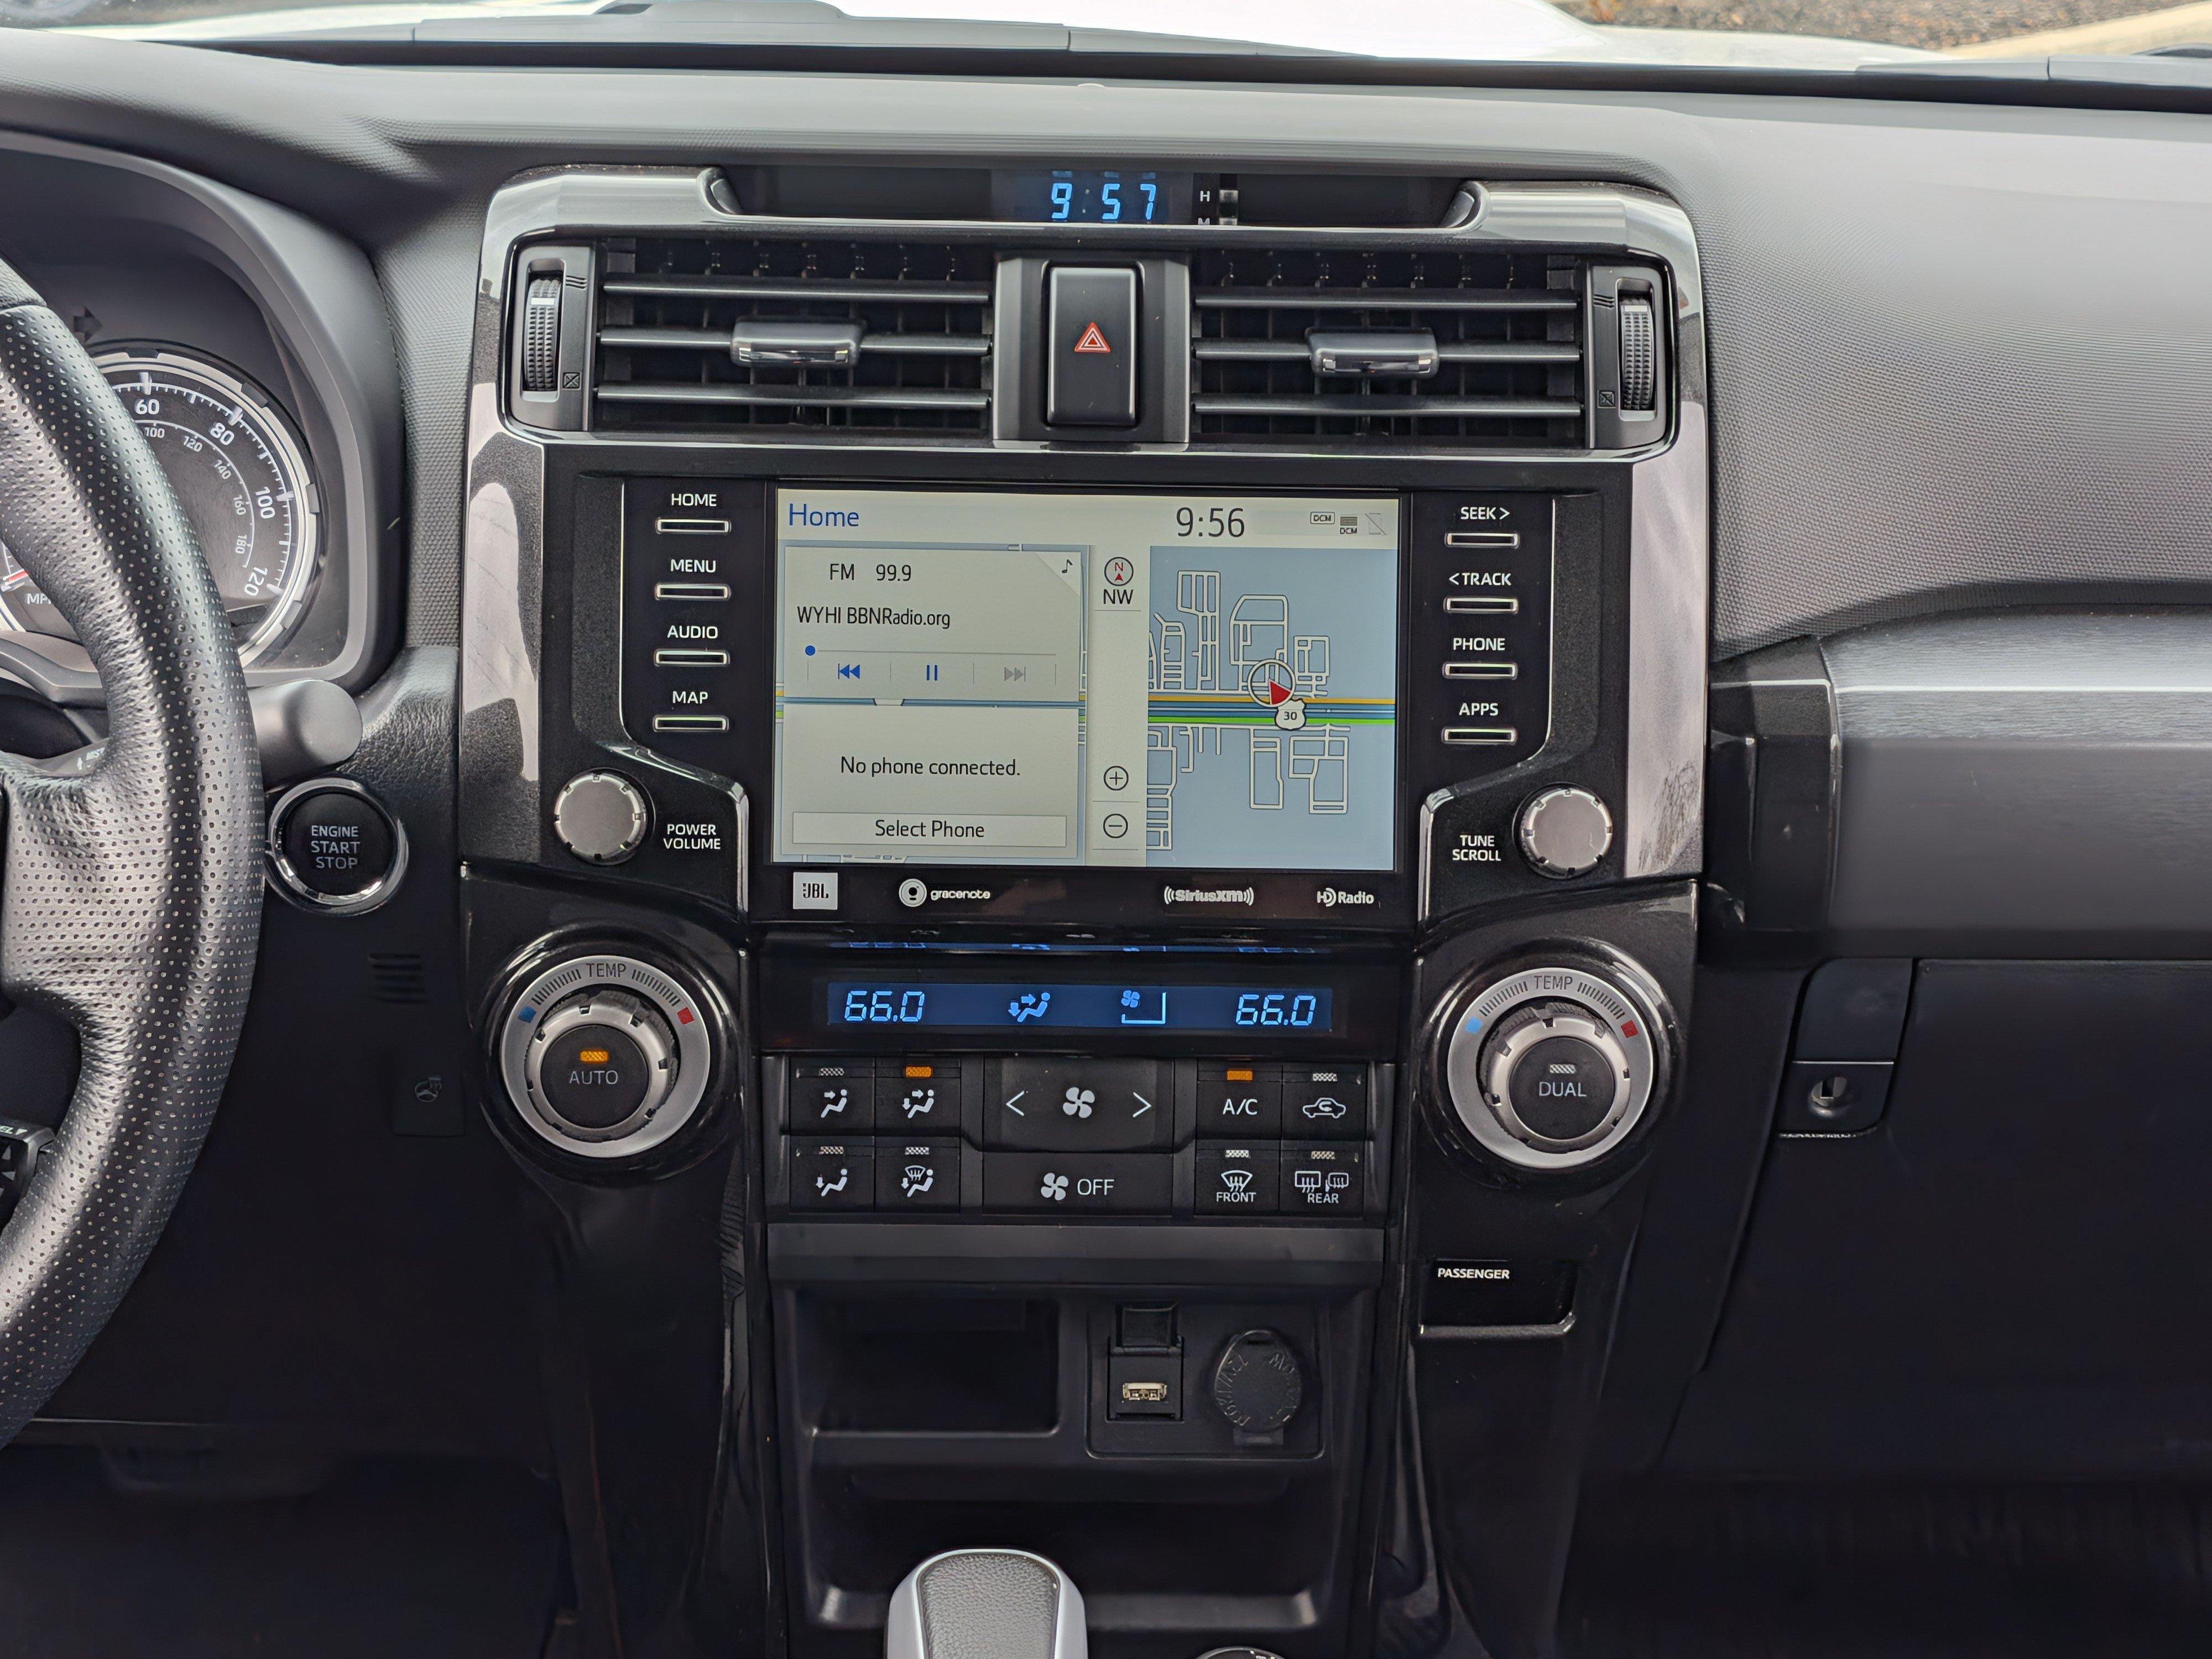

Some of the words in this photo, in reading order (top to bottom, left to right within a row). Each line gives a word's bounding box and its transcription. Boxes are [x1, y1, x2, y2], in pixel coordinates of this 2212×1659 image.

[1051, 183, 1156, 220] 9:57
[1199, 190, 1211, 202] H
[134, 399, 160, 415] 60
[144, 427, 165, 439] 100
[210, 422, 234, 446] 80
[182, 436, 202, 452] 120
[212, 459, 232, 480] 140
[232, 495, 247, 515] 160
[254, 487, 275, 519] 100
[671, 493, 717, 507] HOME
[789, 503, 859, 527] Home
[1460, 507, 1496, 520] SEEK
[1176, 507, 1245, 538] 9:56
[235, 534, 248, 555] 180
[670, 559, 716, 573] MENU
[830, 563, 855, 581] FM
[875, 564, 912, 582] 99.9
[1114, 562, 1124, 572] N
[244, 567, 268, 597] 120
[1462, 572, 1511, 586] TRACK
[27, 593, 51, 605] MP
[1103, 589, 1134, 604] NW
[797, 606, 842, 624] WYHI
[847, 607, 951, 629] BBNRadio.org
[667, 625, 718, 639] AUDIO
[1453, 637, 1505, 651] PHONE
[672, 691, 708, 705] MAP
[1284, 711, 1297, 721] 30
[1459, 702, 1499, 716] APPS
[841, 757, 866, 774] No
[872, 758, 923, 777] phone
[929, 759, 1020, 776] connected.
[311, 826, 358, 837] ENGINE
[667, 823, 716, 836] POWER
[875, 820, 926, 837] Select
[932, 820, 984, 838] Phone
[310, 841, 360, 853] START
[663, 838, 721, 850] VOLUME
[1460, 836, 1494, 847] TUNE
[1452, 849, 1501, 862] SCROLL
[316, 857, 358, 869] STOP
[802, 883, 829, 899] JBL
[930, 889, 990, 901] gracenote
[1338, 891, 1374, 904] Radio
[586, 963, 627, 978] TEMP
[1533, 975, 1573, 990] TEMP
[844, 990, 925, 1022] 66.0
[1235, 994, 1317, 1026] 66.0
[569, 1071, 618, 1085] AUTO
[1538, 1082, 1587, 1097] DUAL
[1223, 1099, 1258, 1115] A/C
[1077, 1178, 1114, 1196] OFF
[1217, 1192, 1256, 1202] FRONT
[1307, 1193, 1339, 1204] REAR
[1438, 1268, 1510, 1279] PASSENGER
